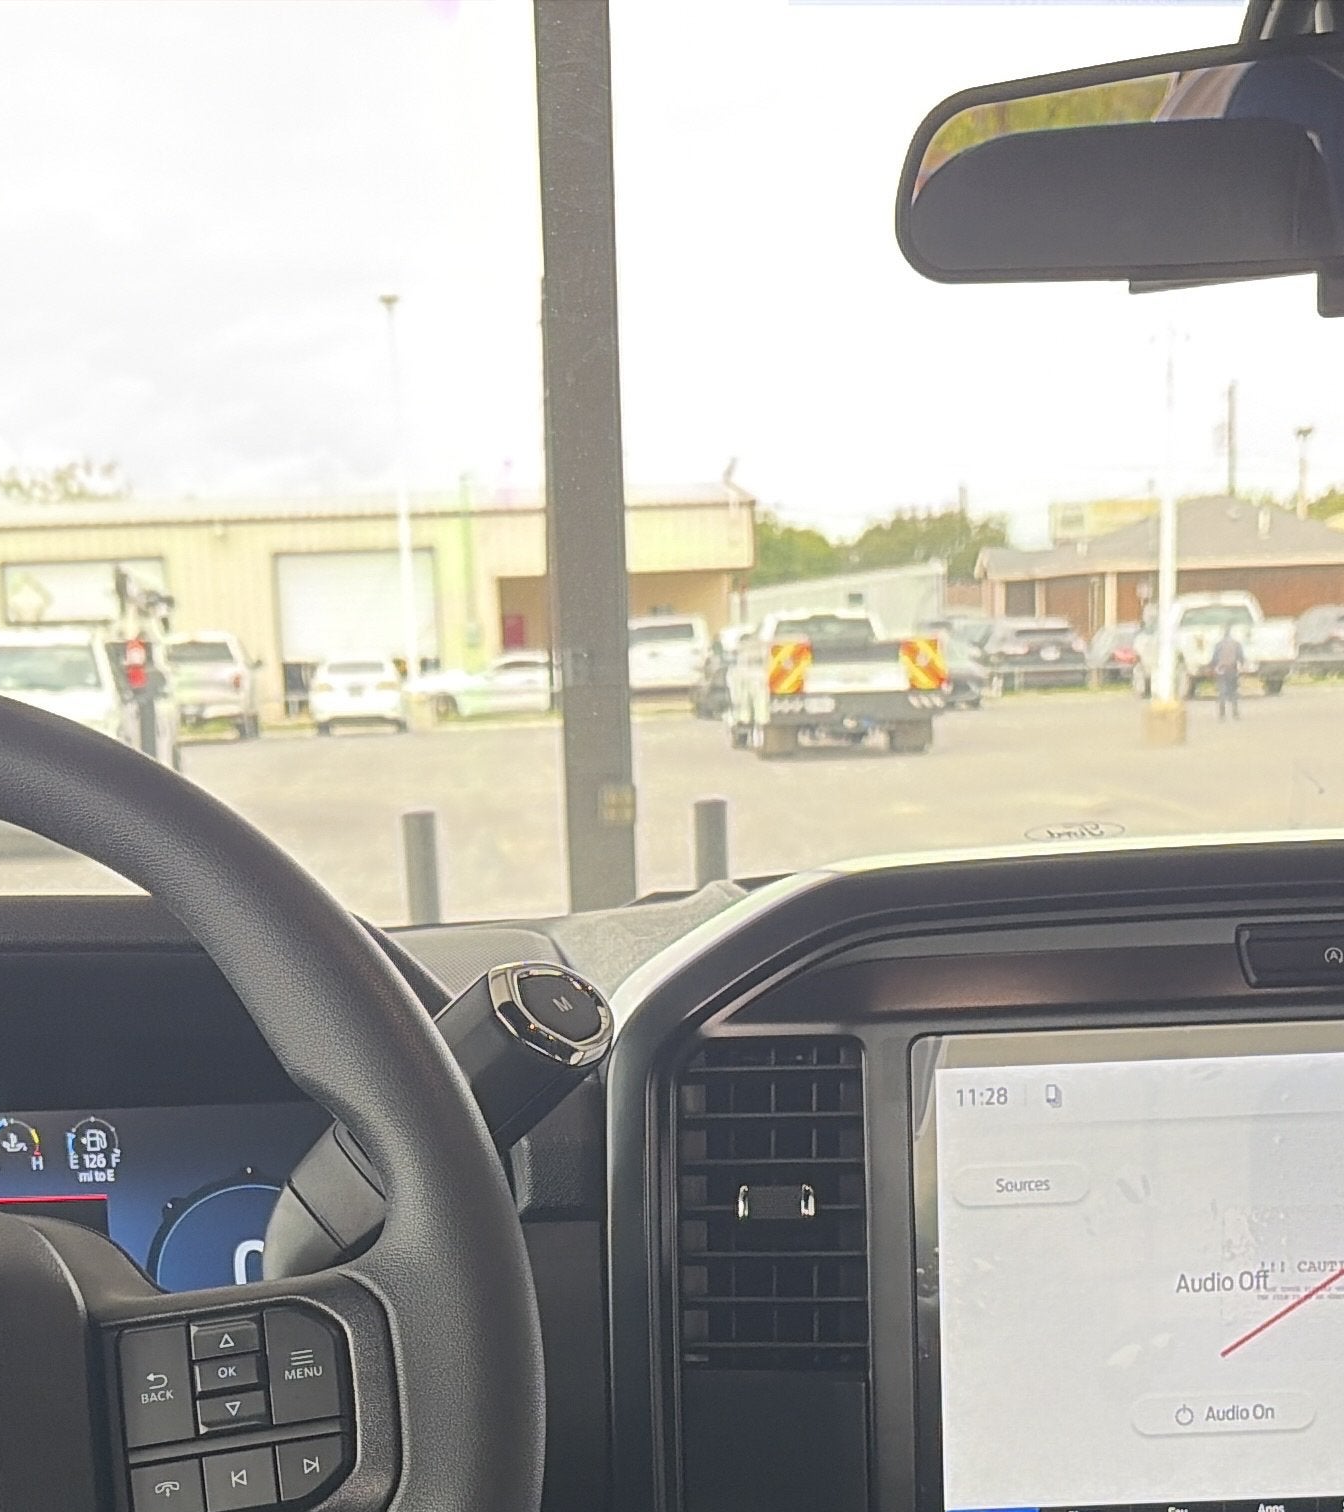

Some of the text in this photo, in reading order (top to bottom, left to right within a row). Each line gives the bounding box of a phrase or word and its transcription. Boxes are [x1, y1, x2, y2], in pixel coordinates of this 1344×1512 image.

[955, 1087, 1008, 1107] 11:28
[31, 1156, 44, 1171] H
[83, 1154, 106, 1168] 126
[996, 1178, 1050, 1193] Sources
[1175, 1269, 1270, 1293] Audio Off
[217, 1366, 237, 1378] OK
[284, 1366, 323, 1381] MENU
[141, 1390, 174, 1404] BACK
[1205, 1404, 1275, 1421] Audio On
